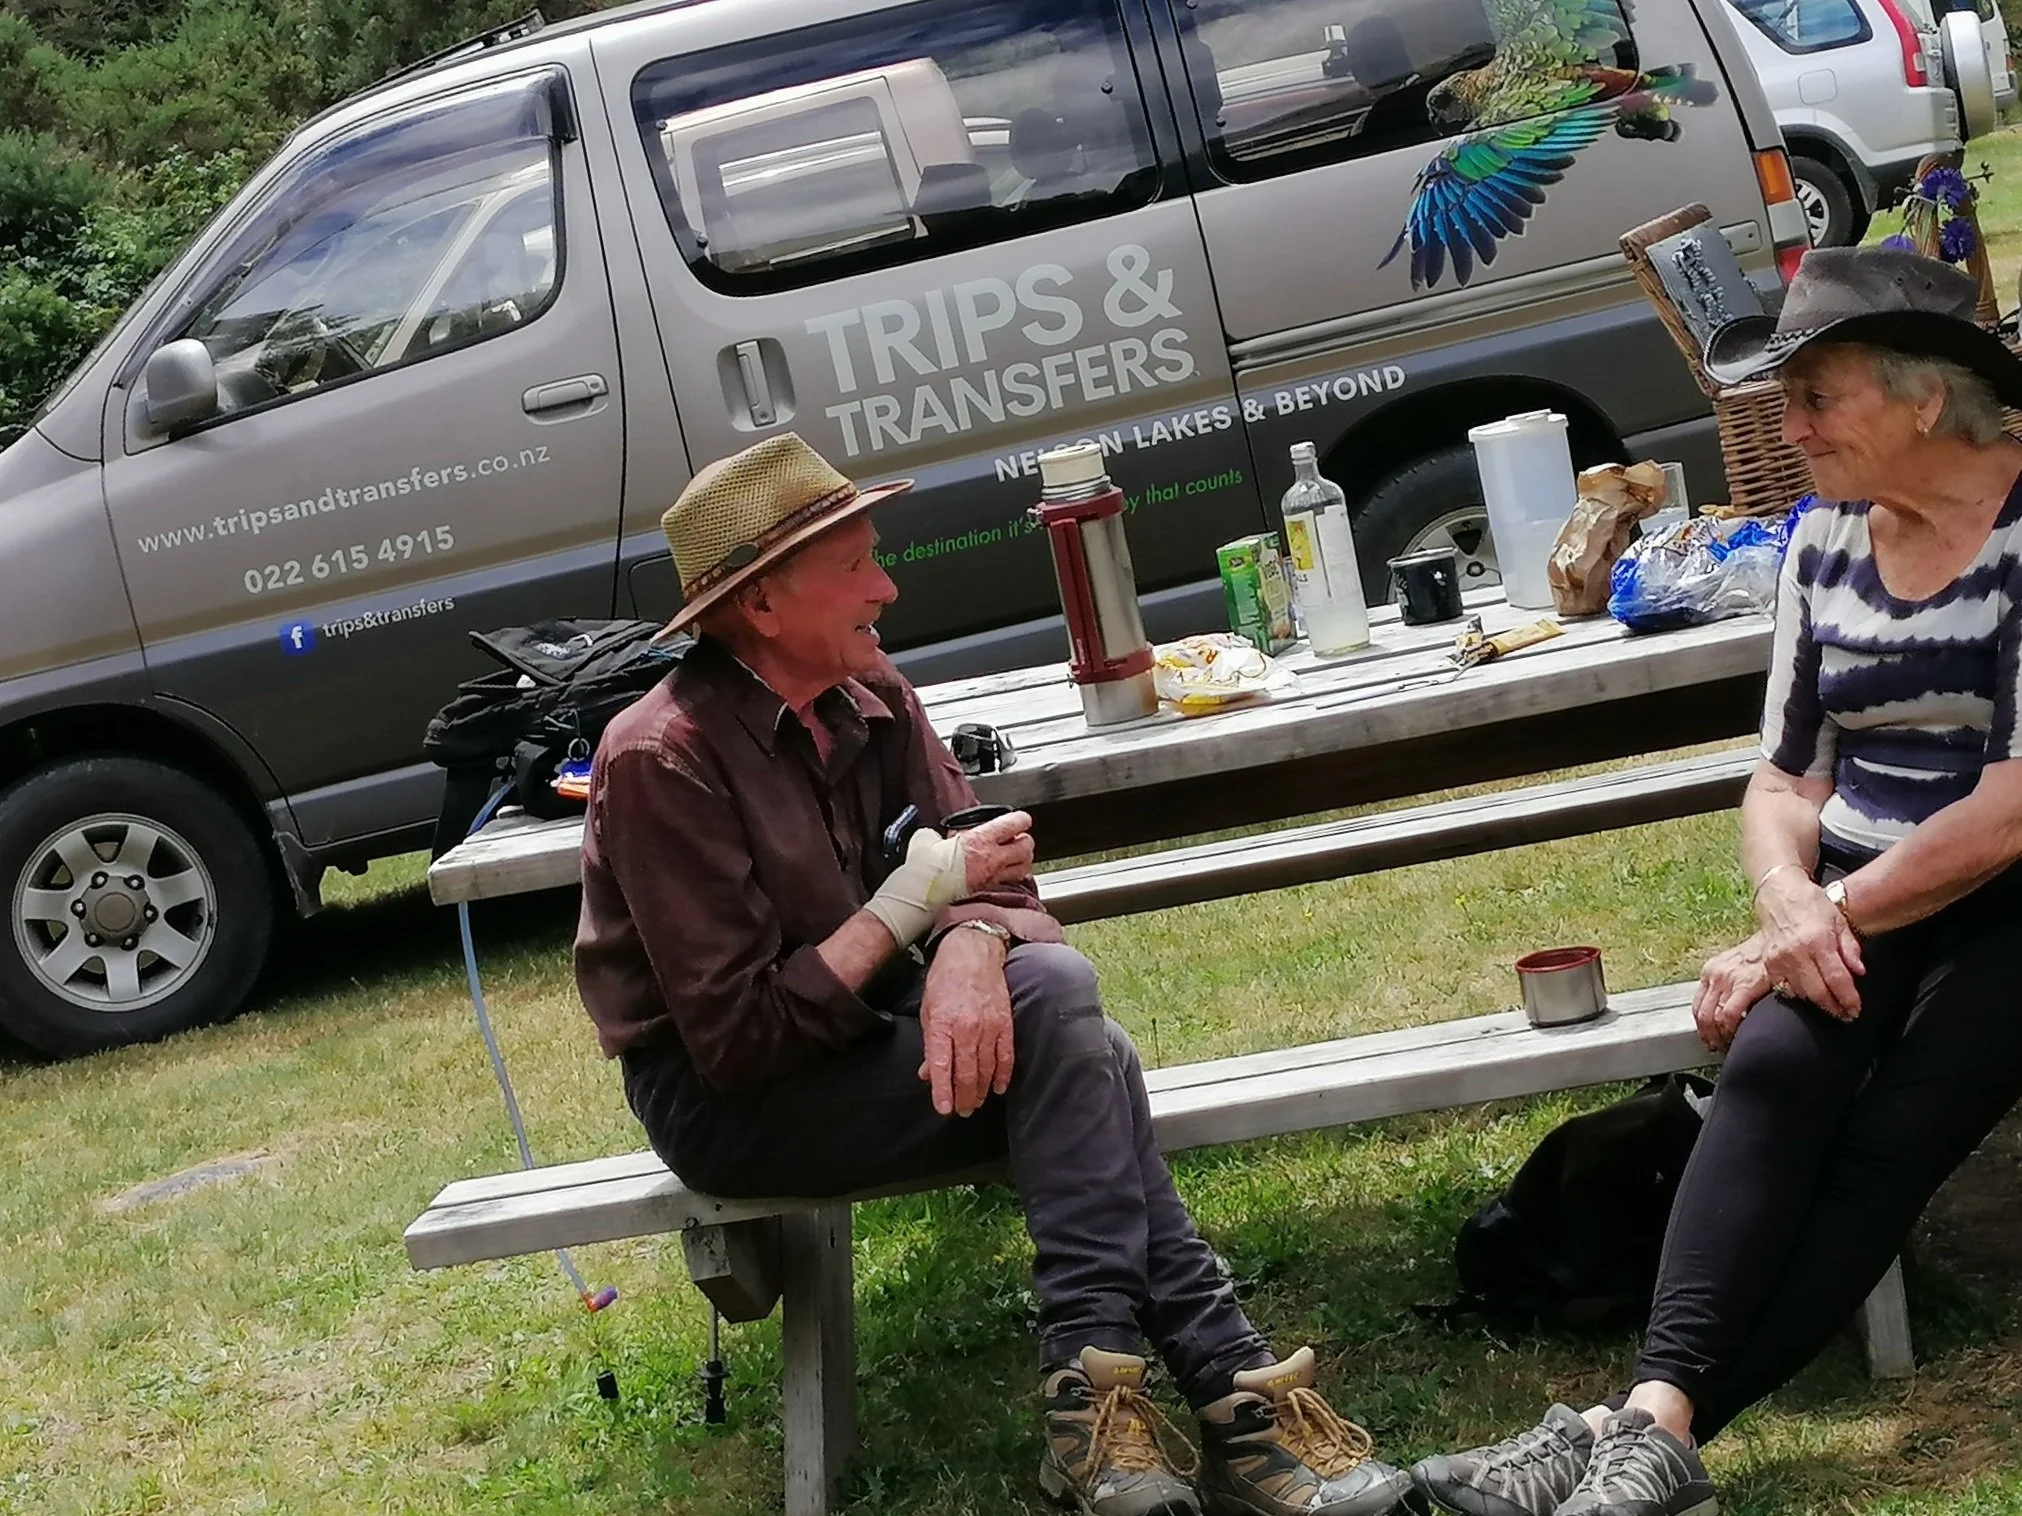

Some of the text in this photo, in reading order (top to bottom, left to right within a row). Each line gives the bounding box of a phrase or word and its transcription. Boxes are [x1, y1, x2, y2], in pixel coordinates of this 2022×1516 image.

[804, 243, 1184, 394] TRIPS &
[824, 327, 1196, 458] TRANSFERS
[994, 364, 1407, 483] NEN LAKES & BEYOND
[136, 443, 552, 554] www.tripsandtransfers.co.nz
[873, 548, 898, 568] he
[903, 526, 1002, 562] destination
[1146, 482, 1180, 505] that
[1185, 467, 1243, 496] counts
[243, 523, 456, 595] 022 615 4915
[322, 596, 456, 640] trips&transfers
